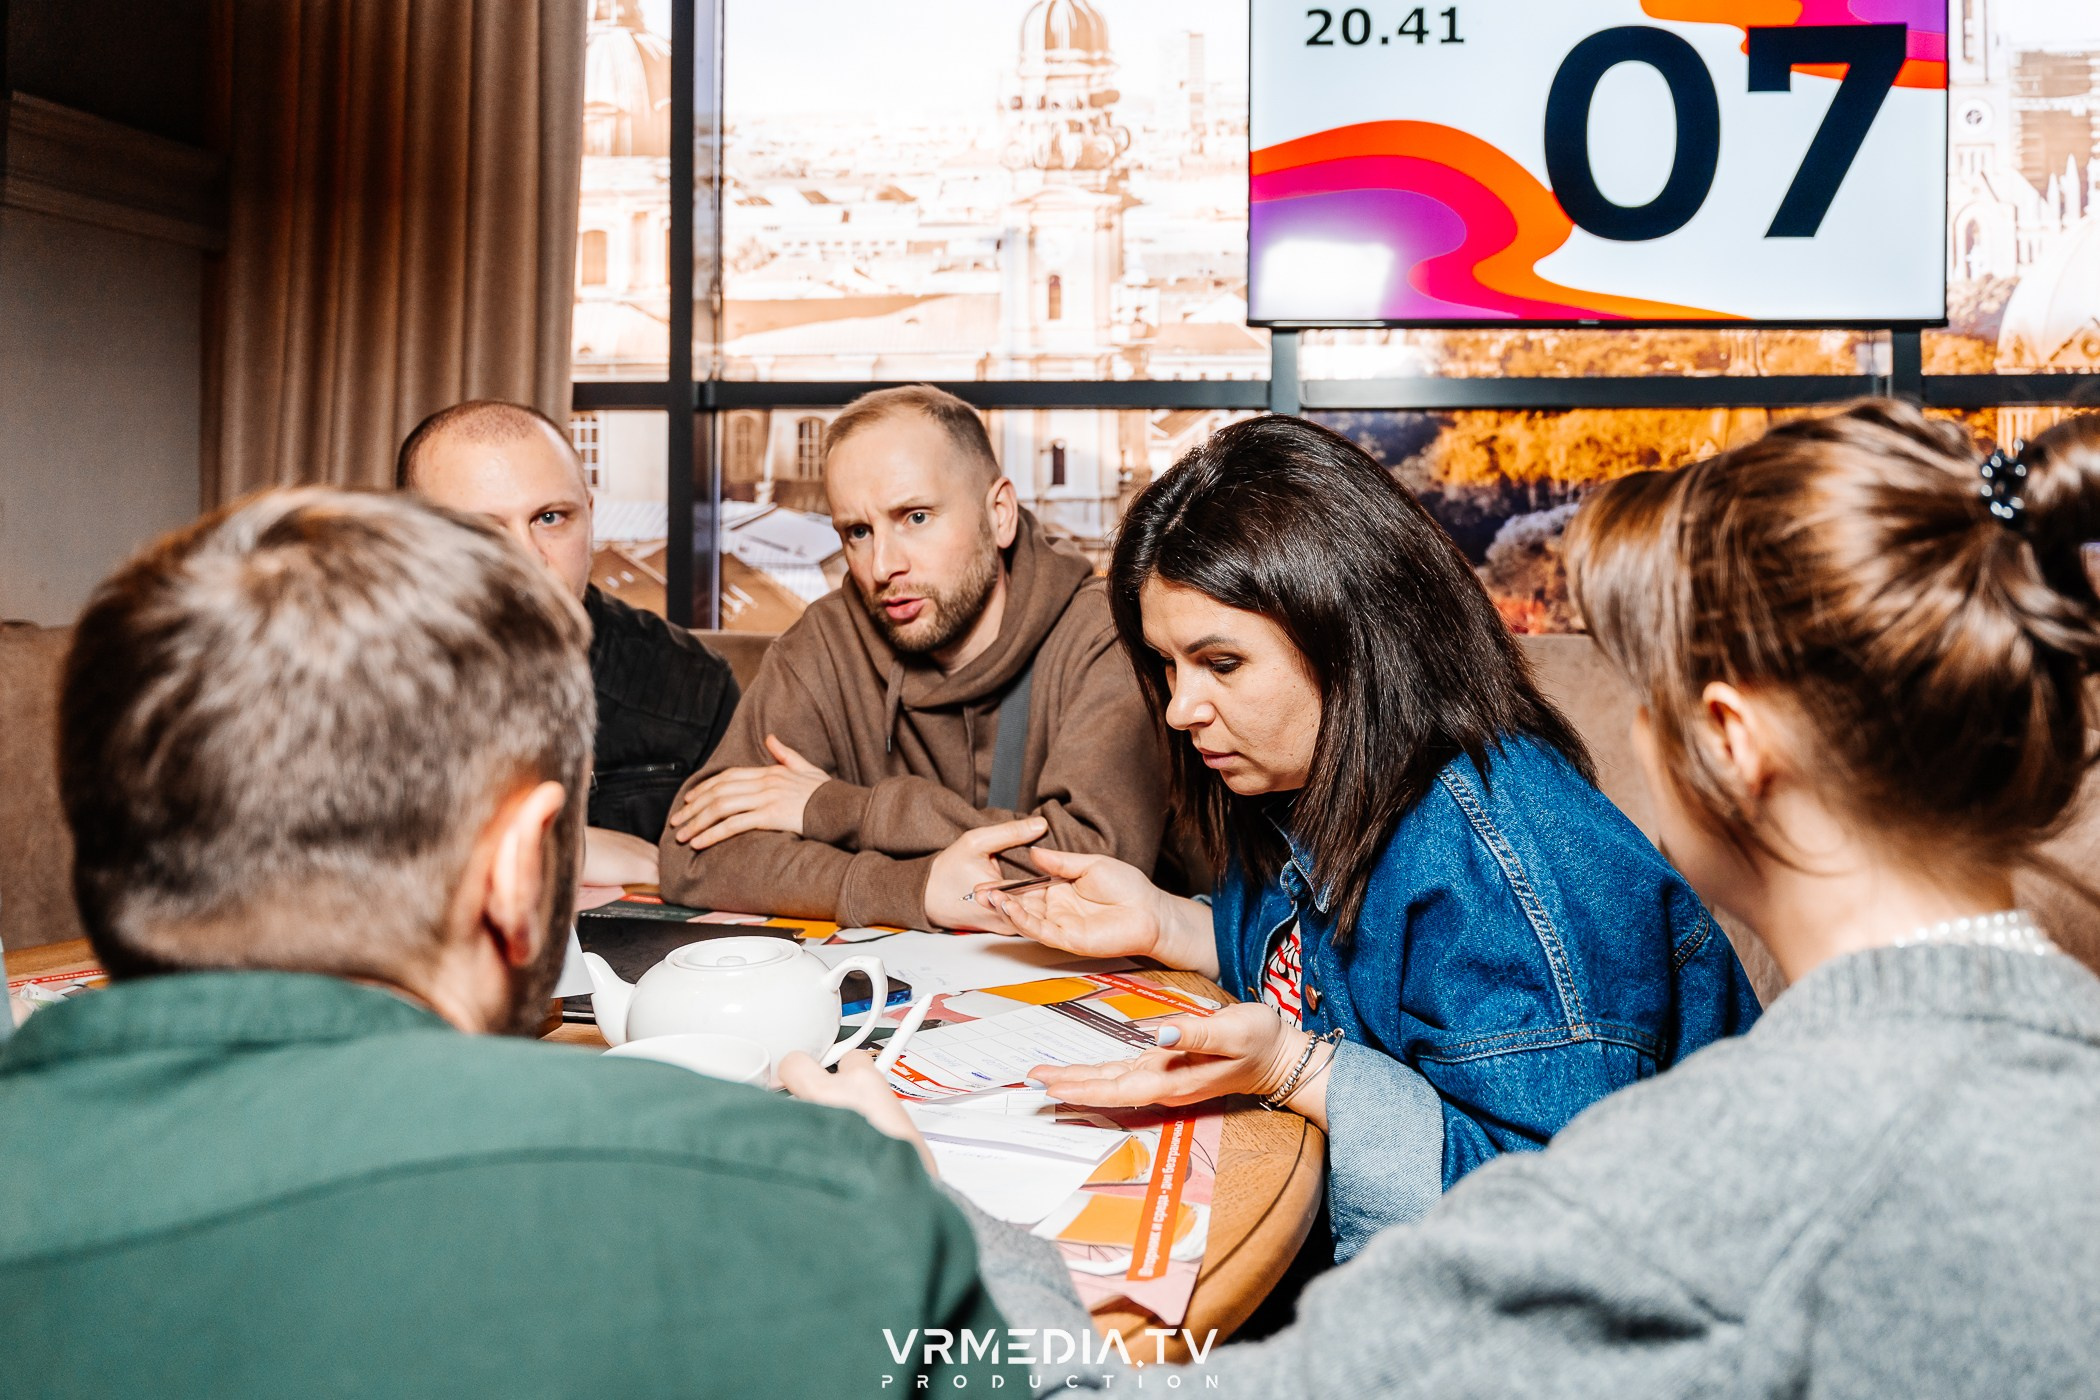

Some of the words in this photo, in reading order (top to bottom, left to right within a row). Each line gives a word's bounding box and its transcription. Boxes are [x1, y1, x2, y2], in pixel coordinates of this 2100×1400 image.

[1306, 7, 1465, 46] 20.41
[1544, 23, 1907, 242] 07
[1176, 1001, 1213, 1017] торник
[1138, 1231, 1161, 1277] Вторник
[1153, 1195, 1169, 1222] среда
[1161, 1174, 1173, 1190] дни
